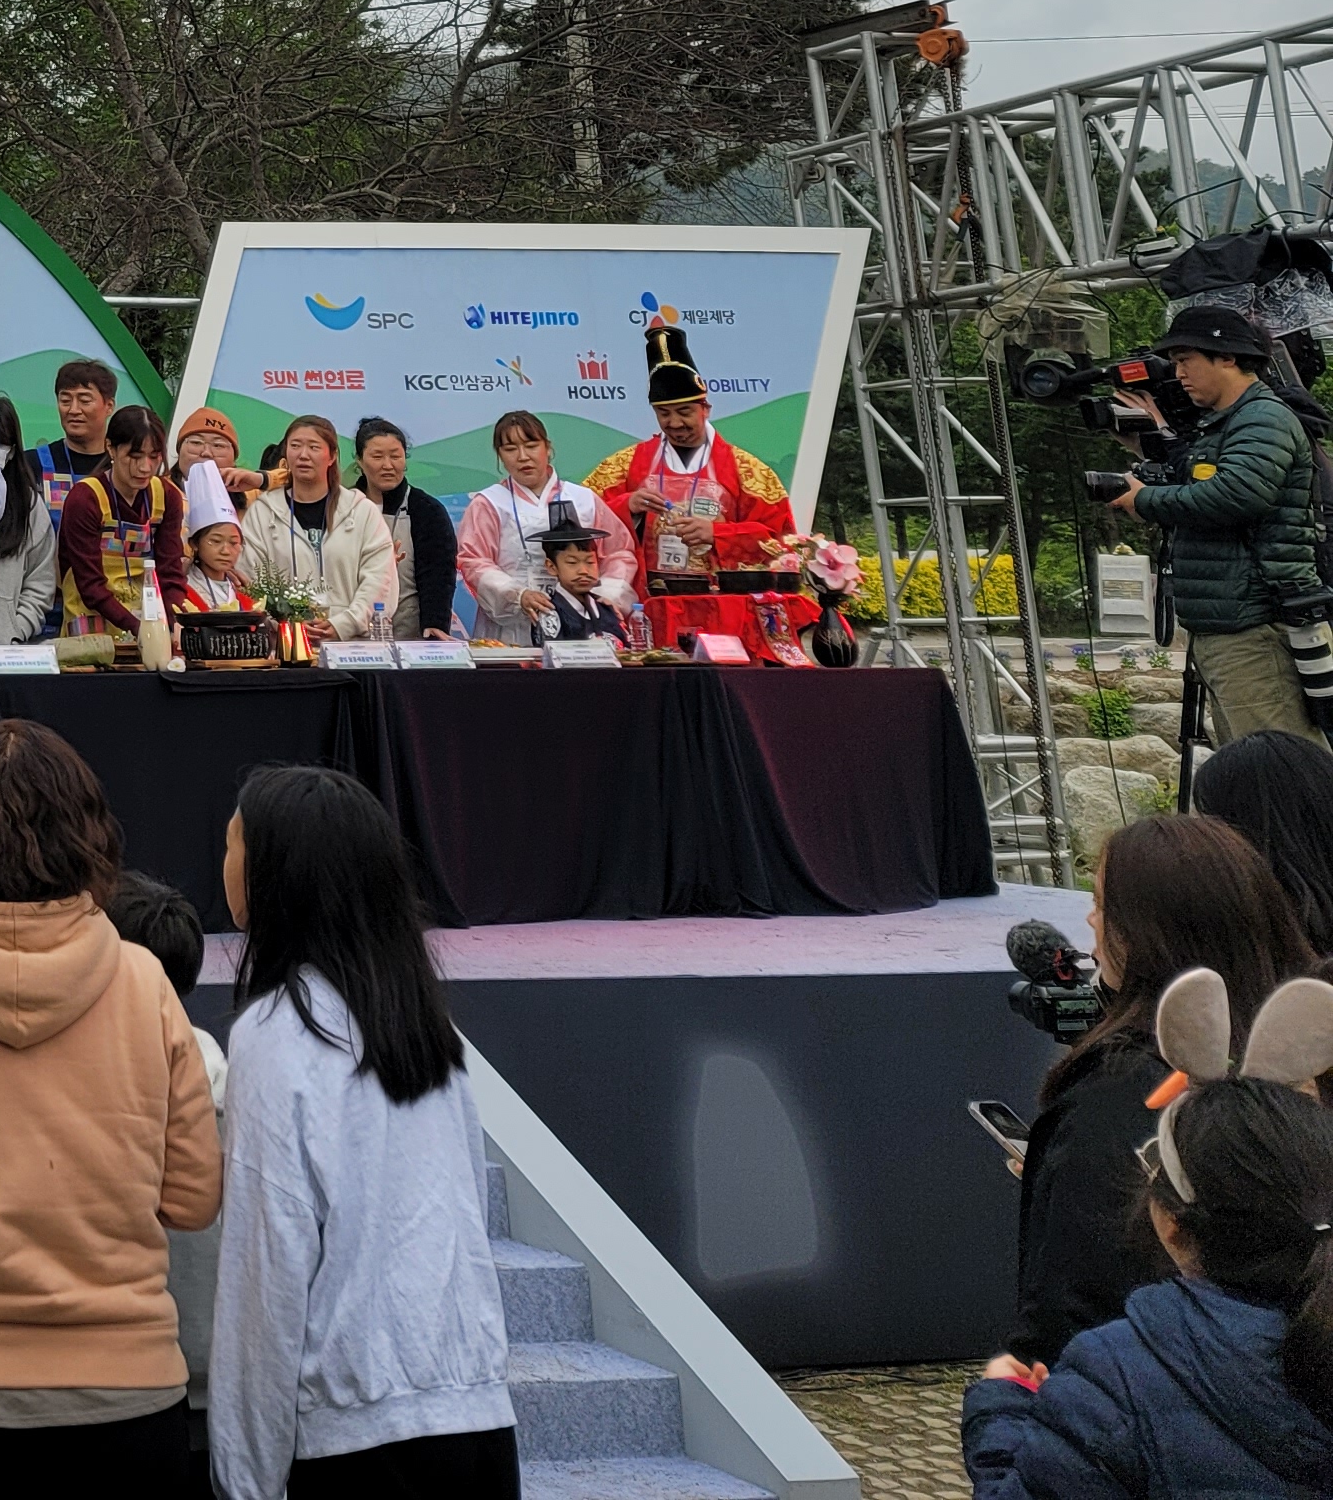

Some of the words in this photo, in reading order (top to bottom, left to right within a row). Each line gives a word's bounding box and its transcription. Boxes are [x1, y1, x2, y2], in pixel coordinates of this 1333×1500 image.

[367, 312, 415, 330] SPC
[628, 310, 649, 327] CJ
[681, 309, 736, 325] 제일제당
[263, 370, 299, 386] SUN
[304, 369, 366, 390] 썬연료
[703, 378, 771, 393] OBILITY
[567, 386, 627, 400] HOLLYS
[205, 418, 226, 430] NY
[664, 552, 682, 563] 76
